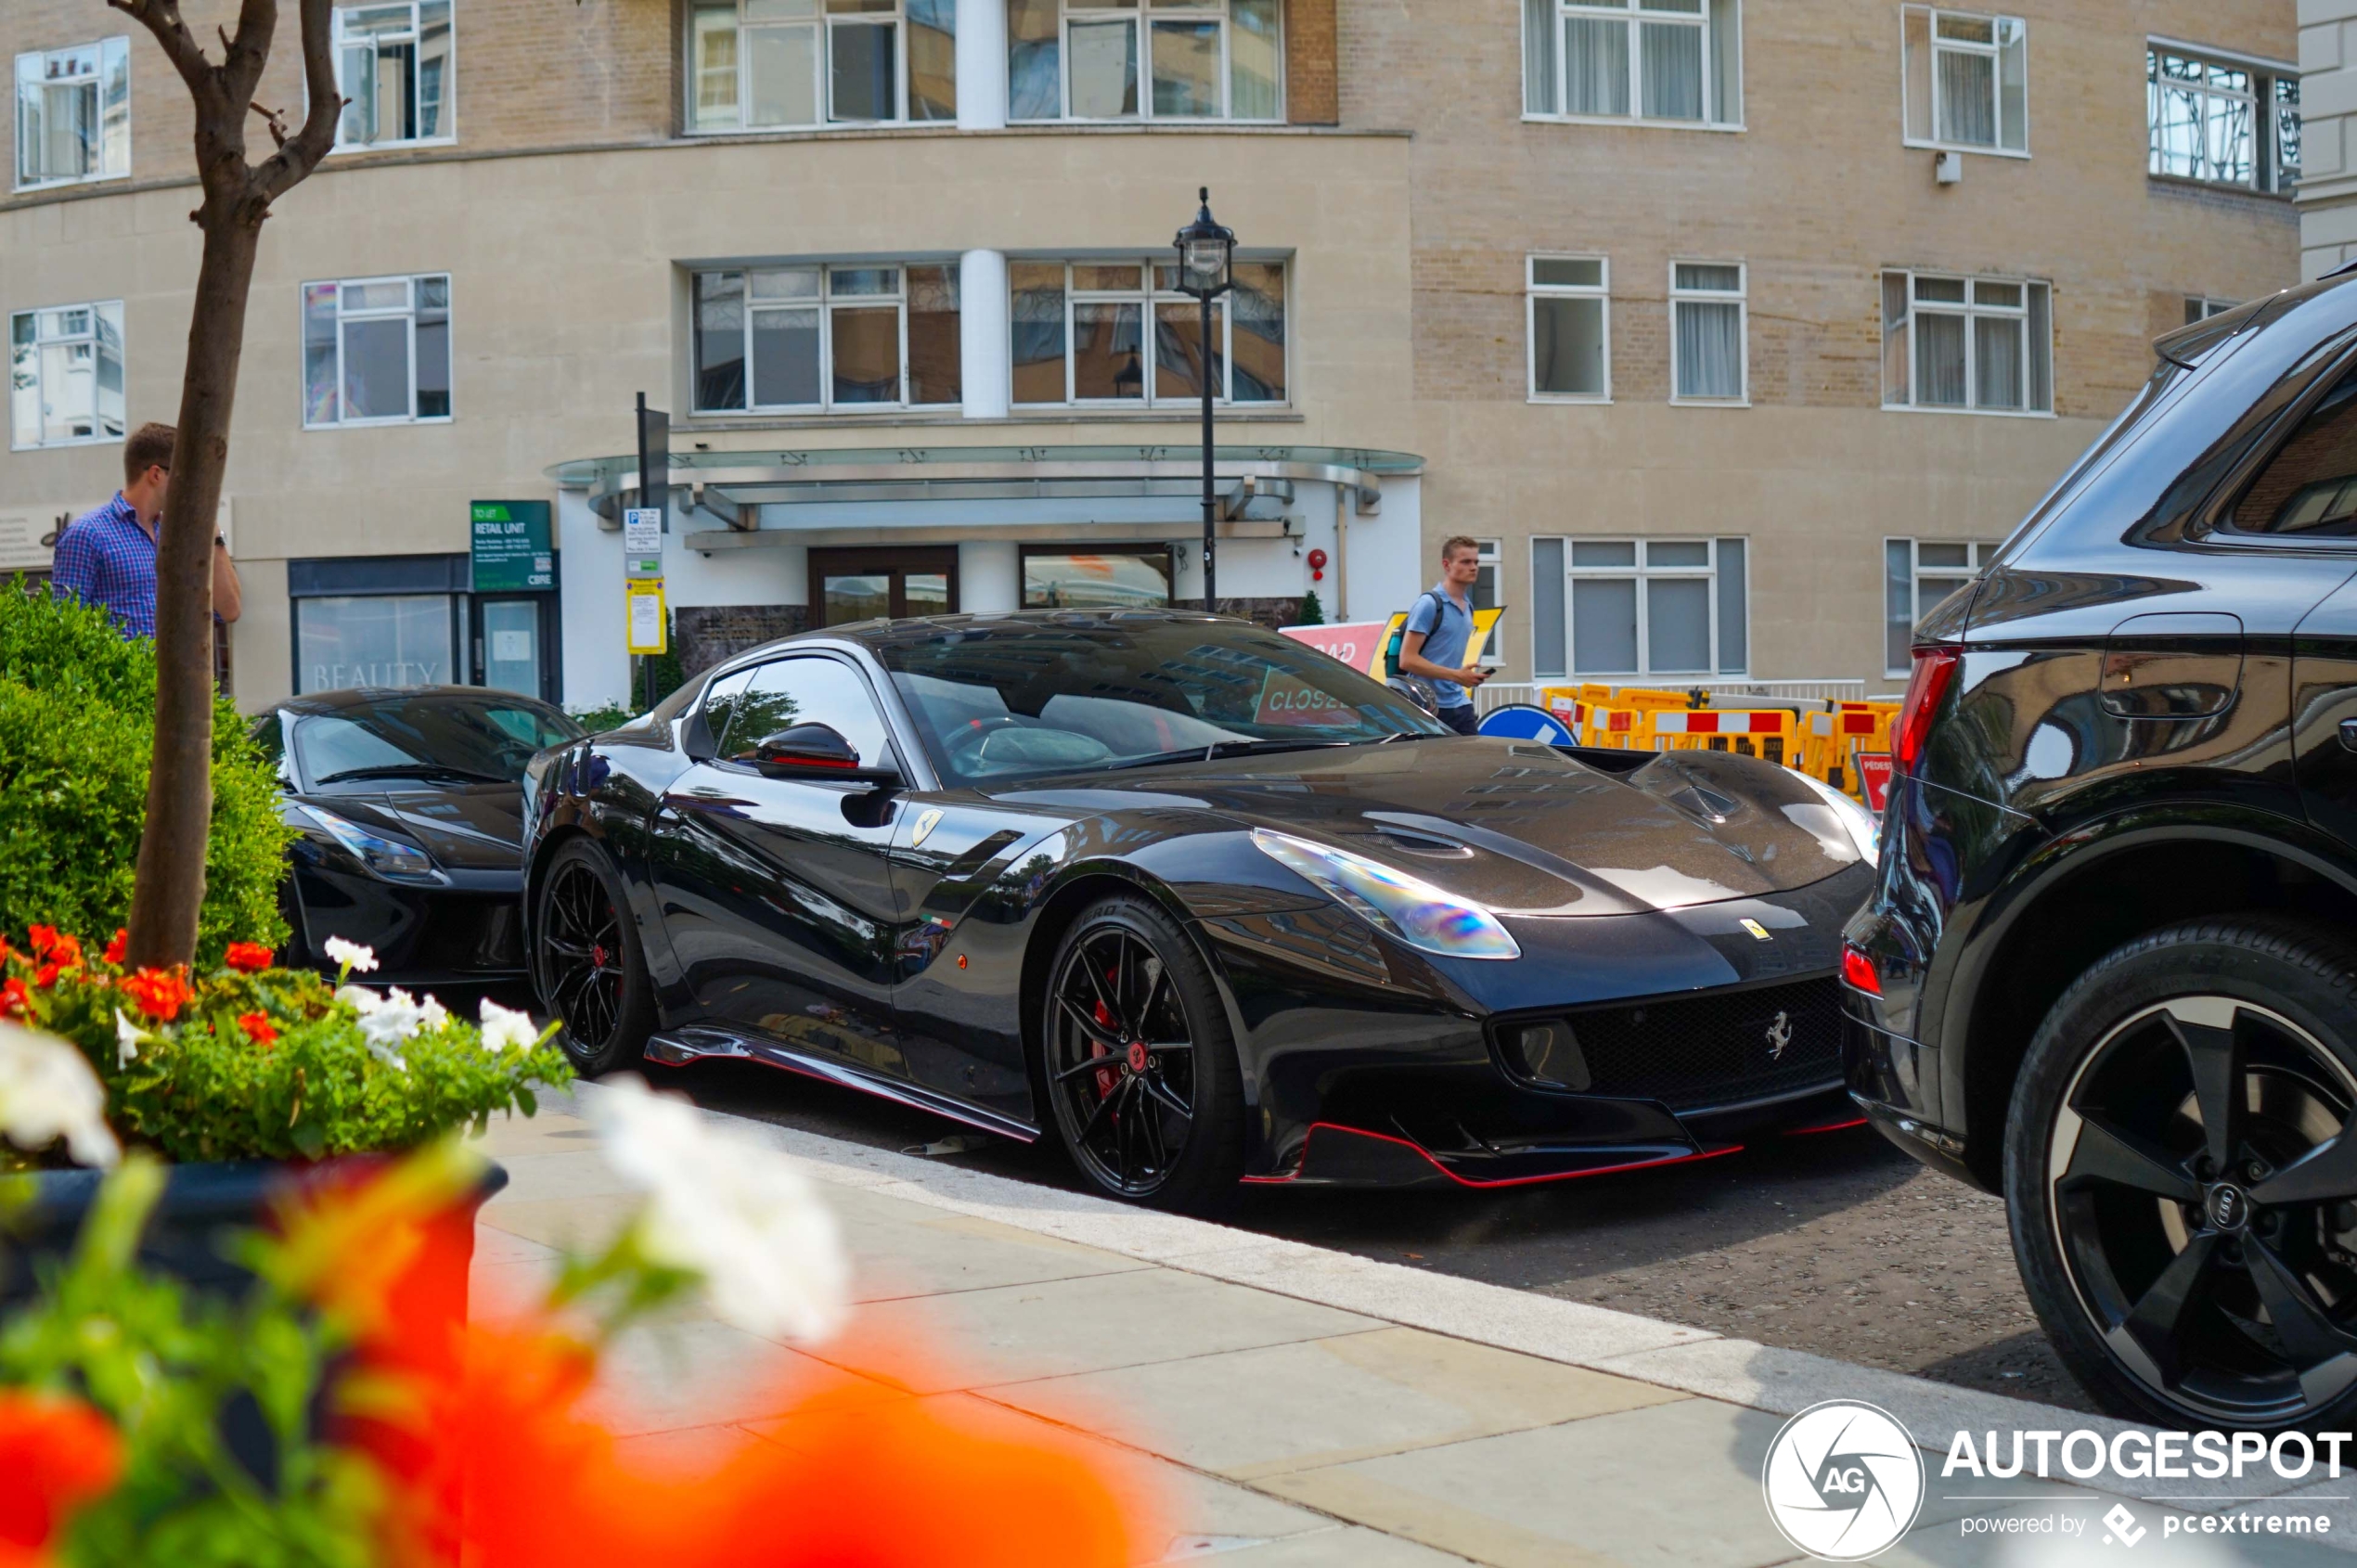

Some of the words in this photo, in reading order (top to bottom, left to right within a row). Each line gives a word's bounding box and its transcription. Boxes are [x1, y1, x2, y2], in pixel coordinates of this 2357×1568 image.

[474, 508, 484, 519] TO
[485, 508, 496, 519] LET
[475, 522, 503, 534] RETAIL
[504, 522, 525, 534] UNIT
[527, 574, 552, 585] CBRE
[315, 662, 438, 692] BEAUTY
